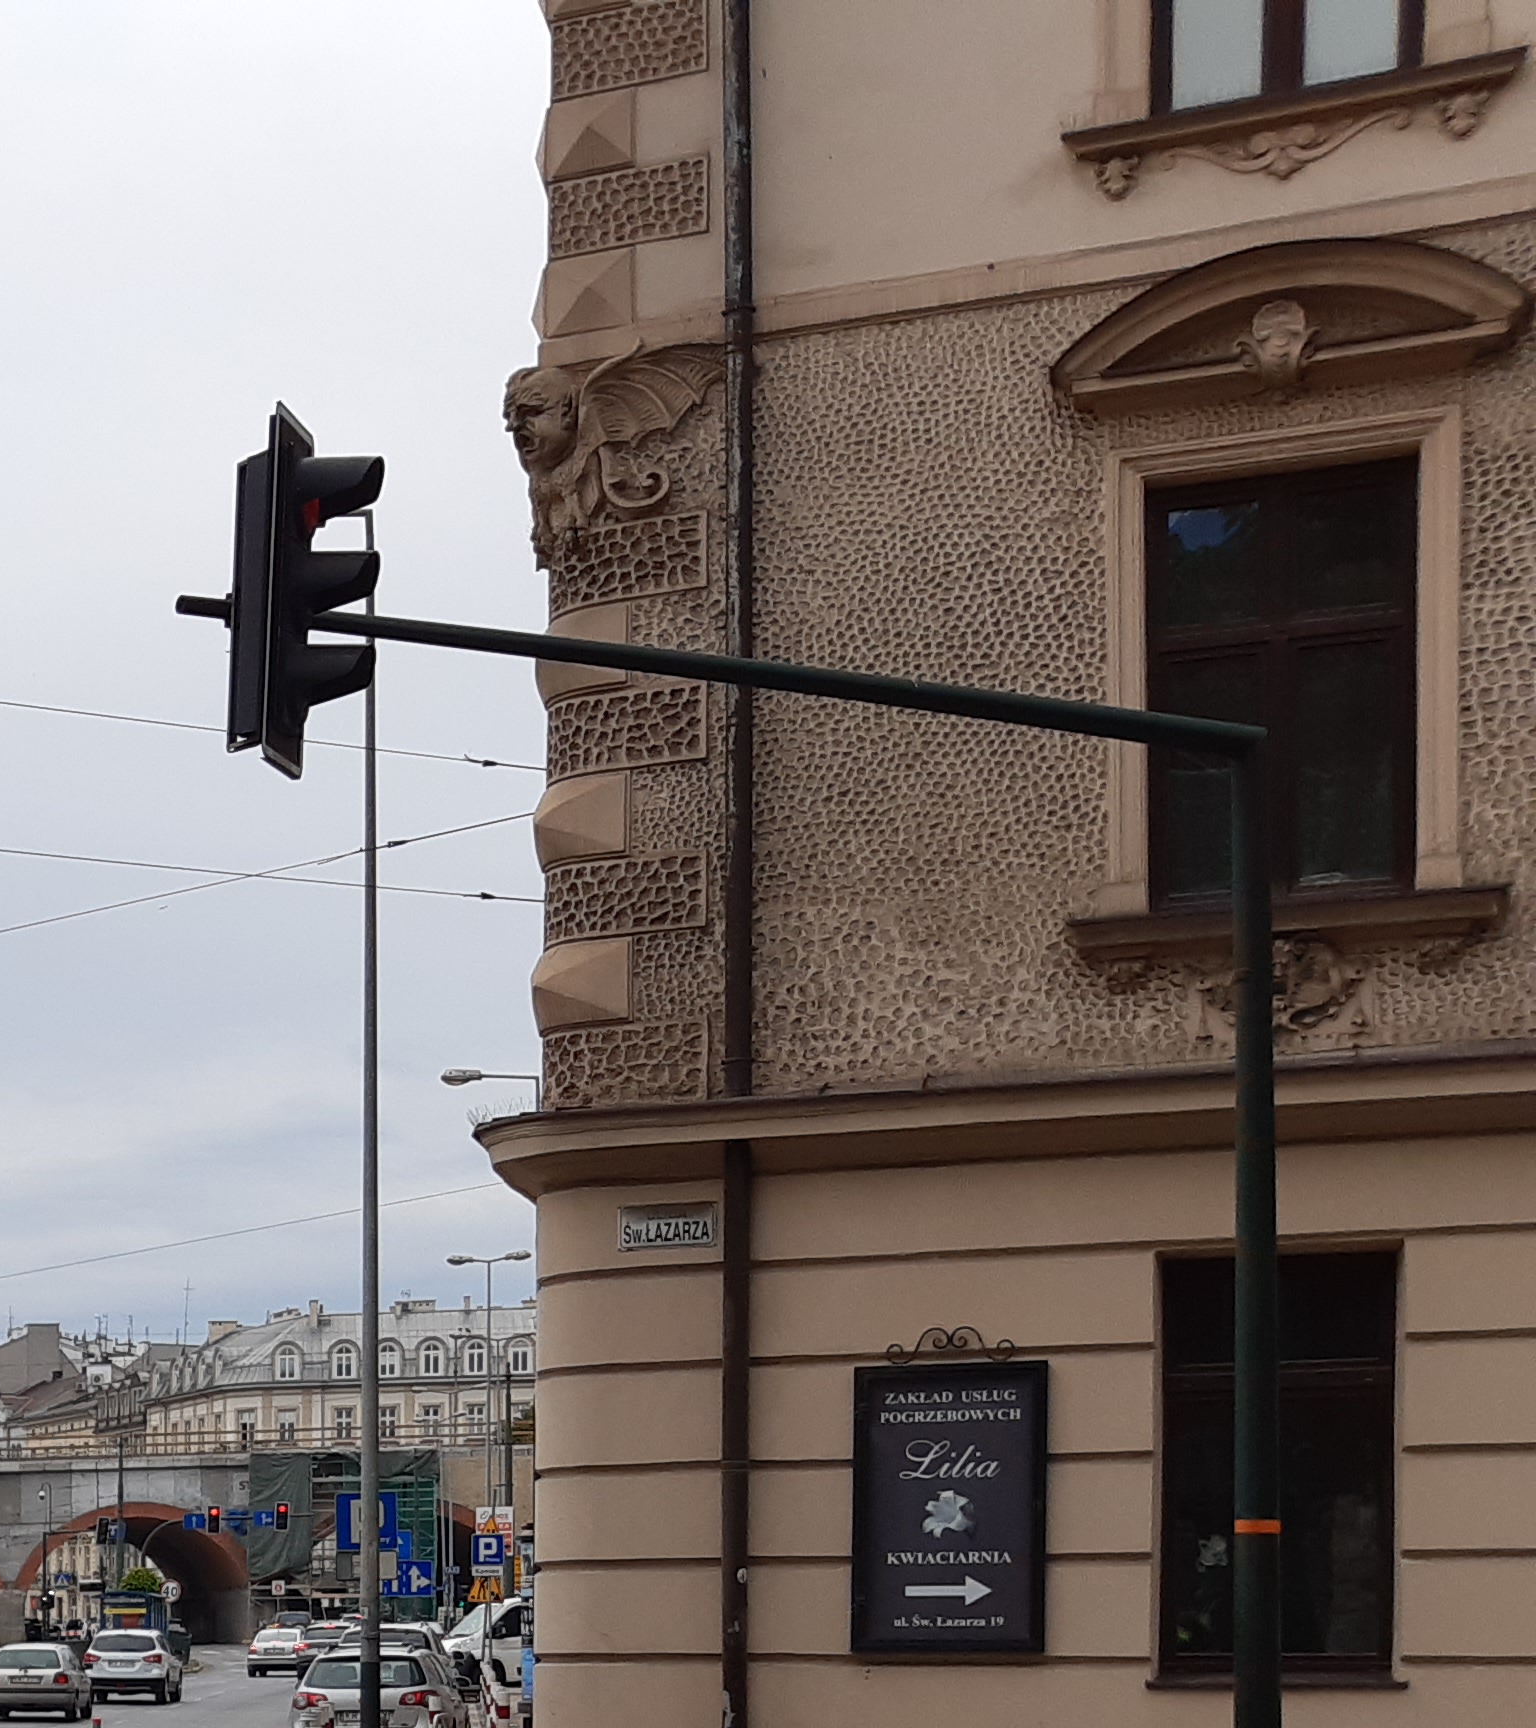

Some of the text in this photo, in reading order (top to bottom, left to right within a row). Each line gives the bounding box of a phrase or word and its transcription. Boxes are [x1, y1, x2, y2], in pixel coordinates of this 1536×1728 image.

[884, 1389, 1017, 1405] ZAKŁAD USŁUG
[880, 1408, 1022, 1424] POGRZEBOWYCH
[899, 1439, 1001, 1480] Lilia
[886, 1551, 1012, 1565] KWIACIARNIA
[162, 1585, 178, 1599] 40
[893, 1613, 1004, 1627] ul. Św. Łazarza 19
